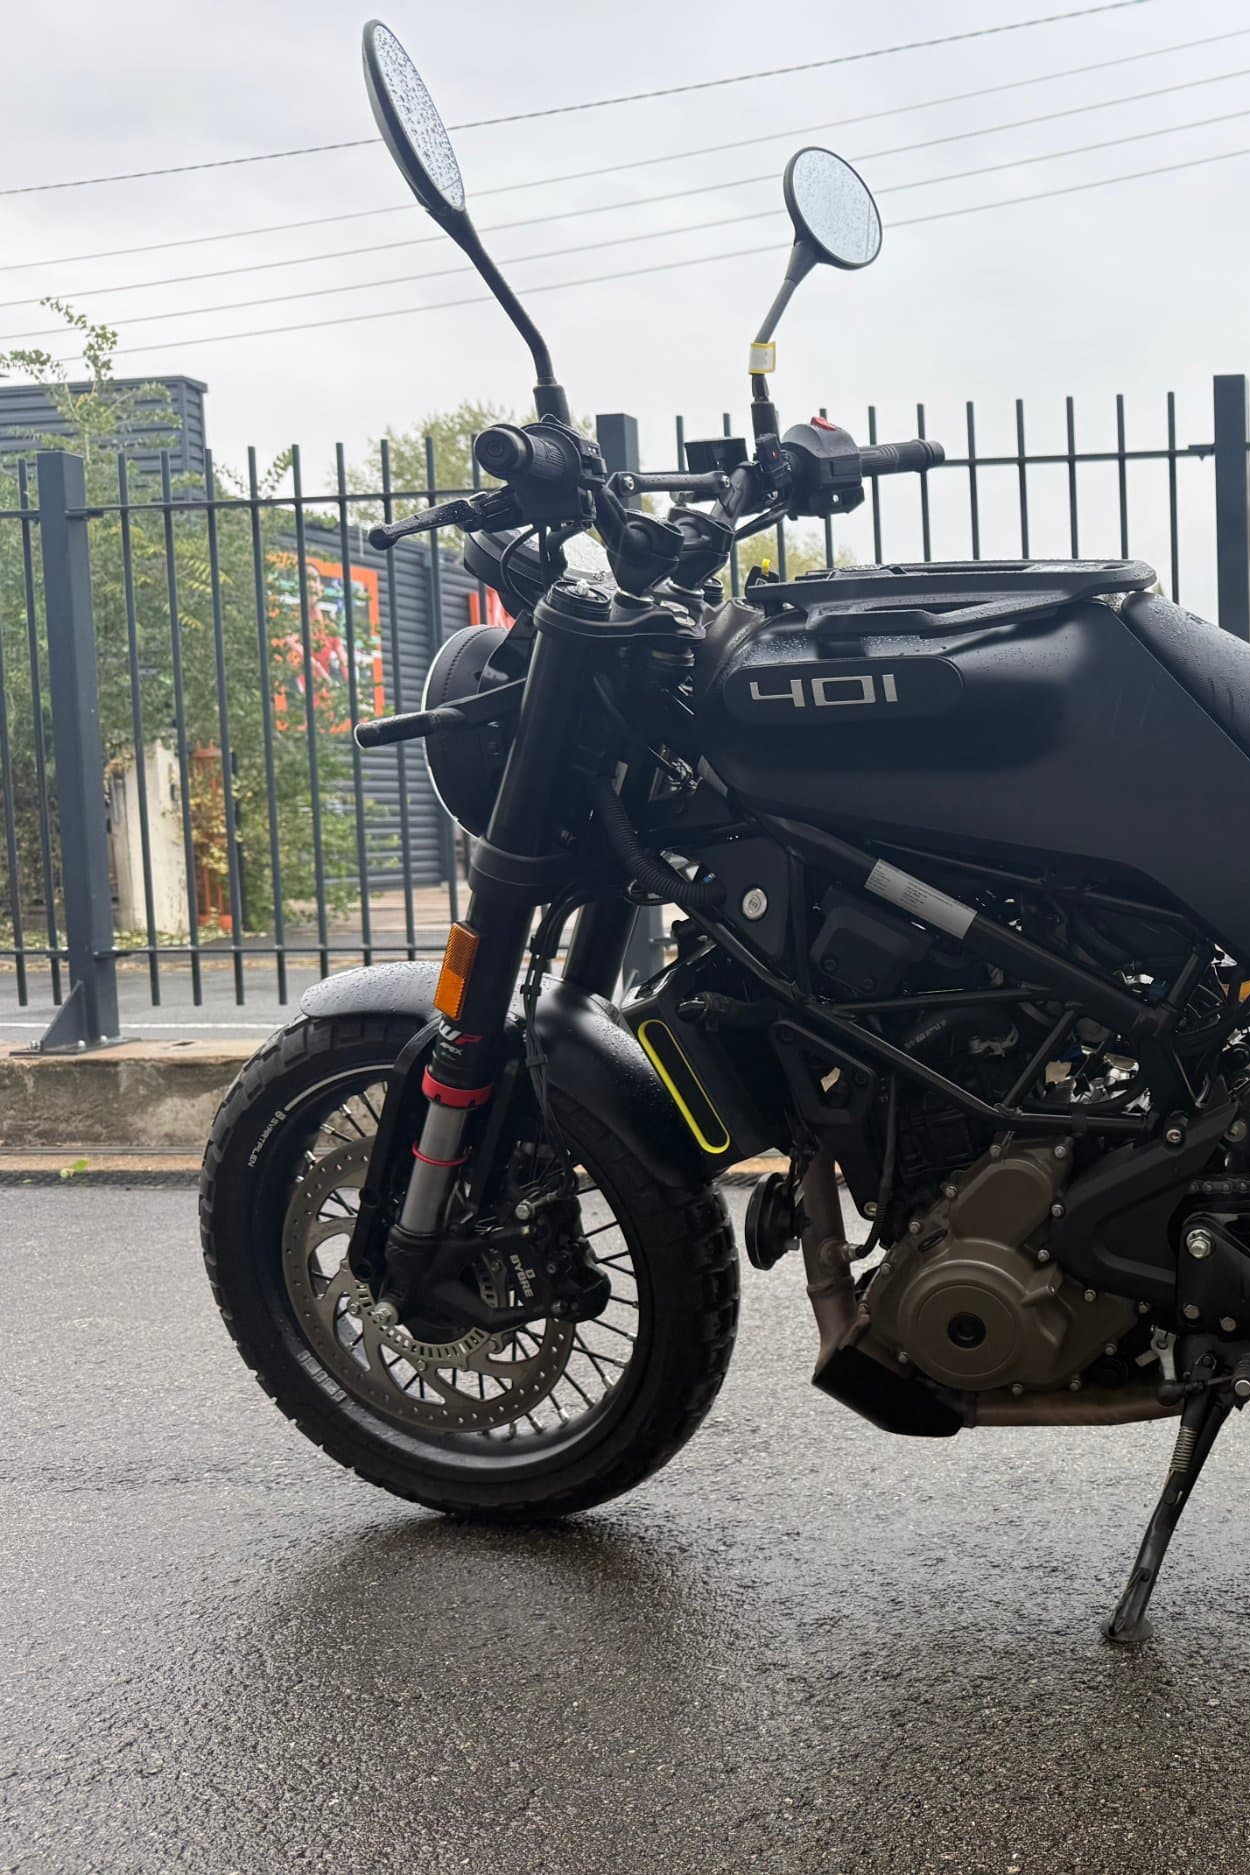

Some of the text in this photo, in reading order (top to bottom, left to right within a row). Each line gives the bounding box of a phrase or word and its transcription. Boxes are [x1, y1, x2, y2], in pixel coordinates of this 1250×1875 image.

[750, 674, 898, 707] 401
[248, 1117, 279, 1168] SVARTPILEN
[510, 1254, 534, 1297] BYBRE
